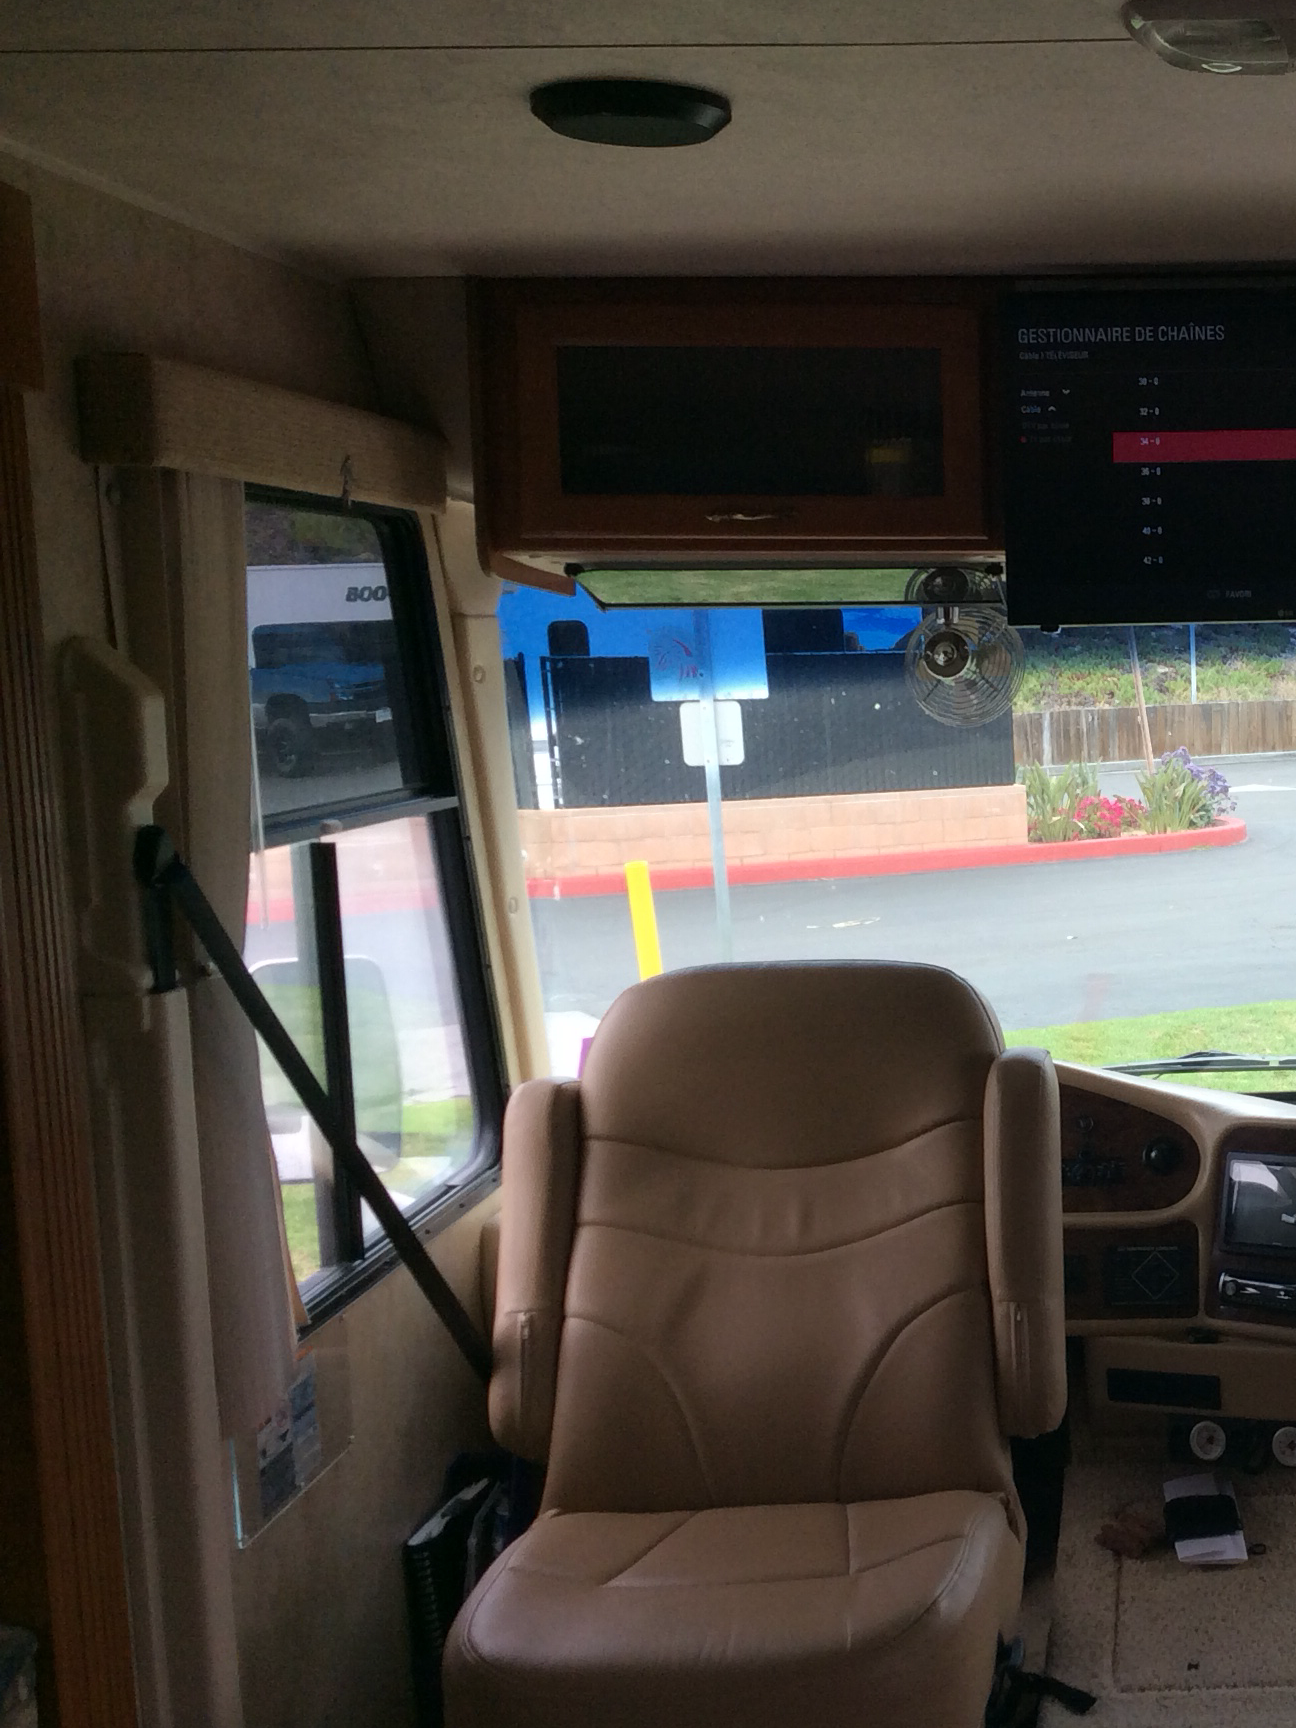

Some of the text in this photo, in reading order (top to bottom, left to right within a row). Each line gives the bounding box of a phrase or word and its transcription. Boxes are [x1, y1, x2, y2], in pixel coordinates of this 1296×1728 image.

[1018, 322, 1225, 344] GESTIONNAIRE DE CHAÎNES
